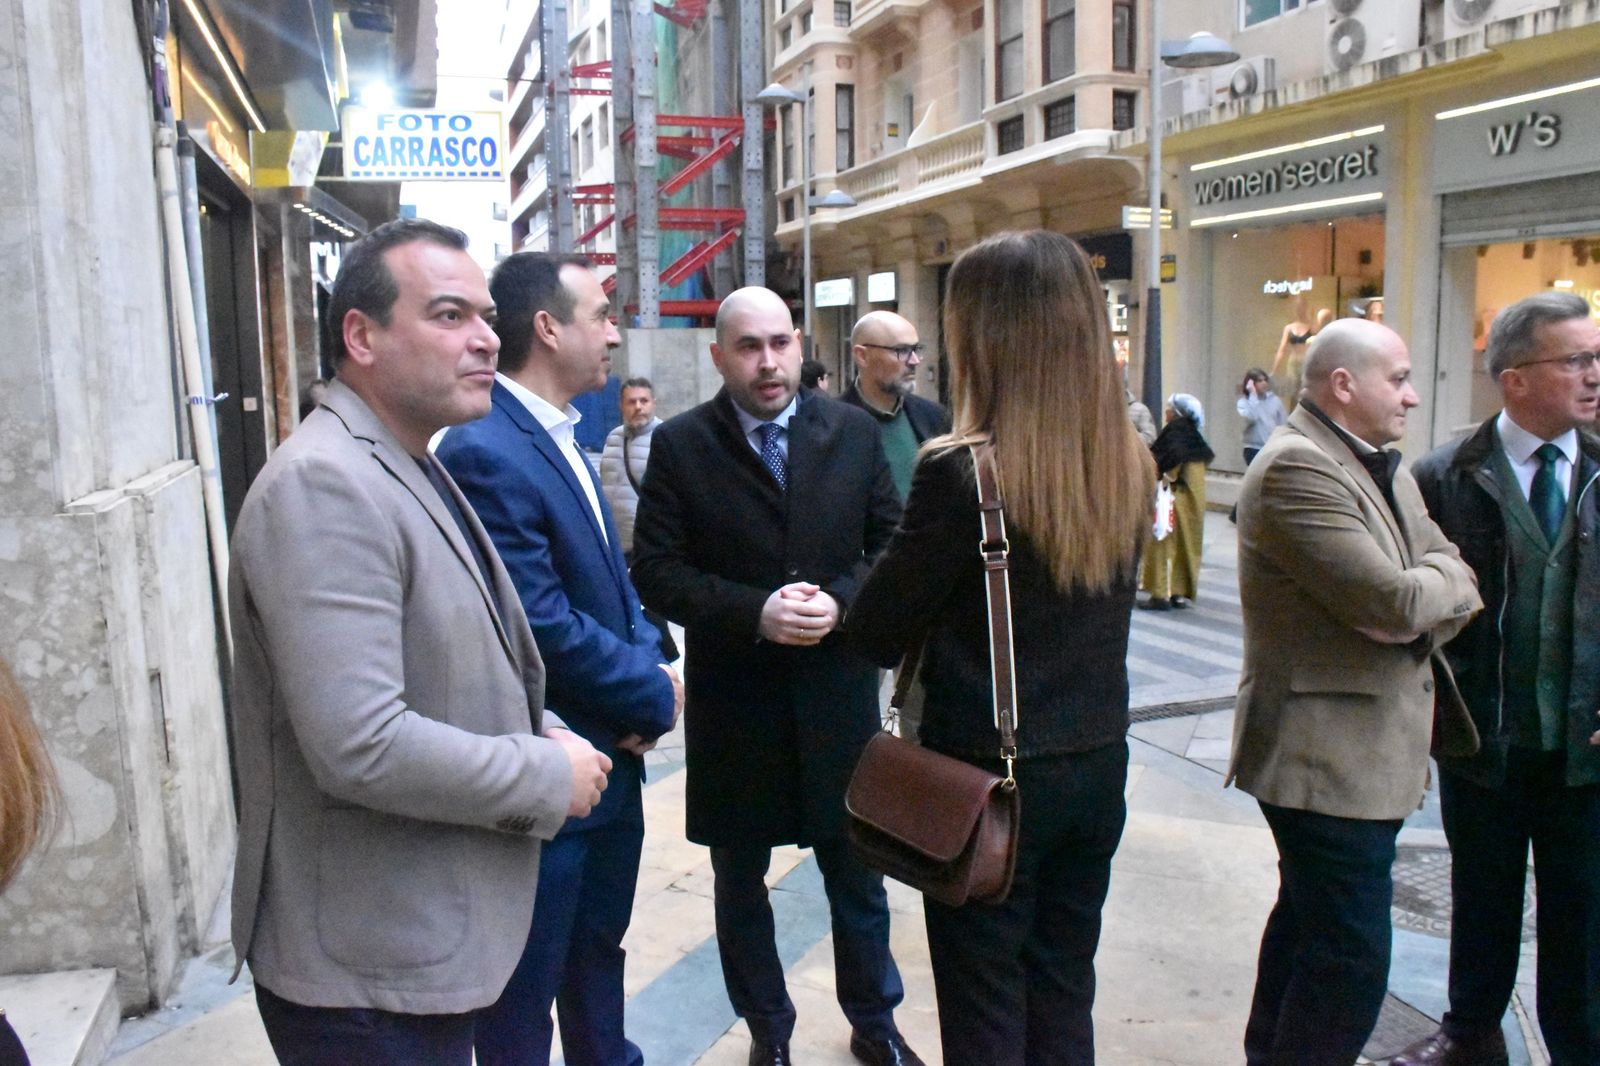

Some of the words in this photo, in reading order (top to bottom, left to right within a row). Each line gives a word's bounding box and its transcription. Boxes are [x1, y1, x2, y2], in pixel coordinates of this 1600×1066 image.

[377, 114, 472, 132] FOTO
[354, 136, 497, 167] CARRASCO
[1195, 144, 1377, 205] women'secret
